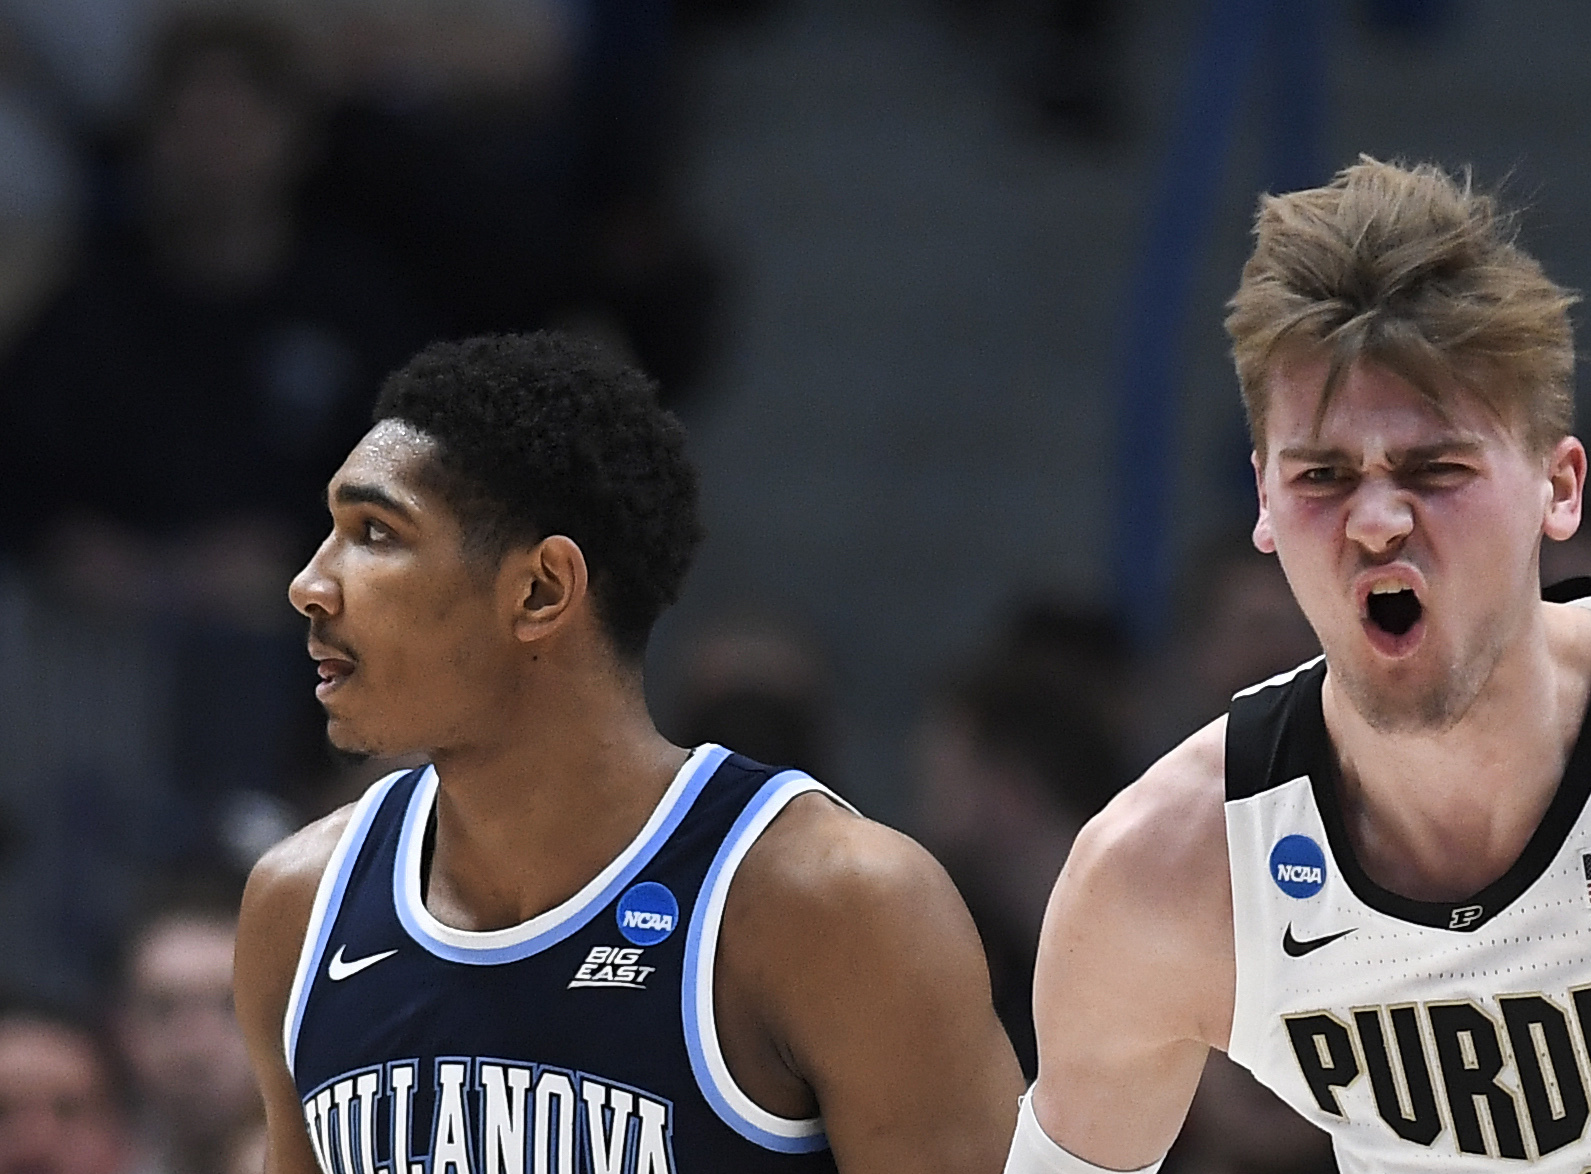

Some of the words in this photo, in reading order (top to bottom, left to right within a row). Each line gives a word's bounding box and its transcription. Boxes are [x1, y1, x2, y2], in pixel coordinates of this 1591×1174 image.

[1277, 863, 1322, 884] NCAA
[622, 910, 673, 932] NCAA
[1449, 905, 1483, 929] P
[584, 946, 644, 965] BIG
[574, 963, 656, 982] EAST
